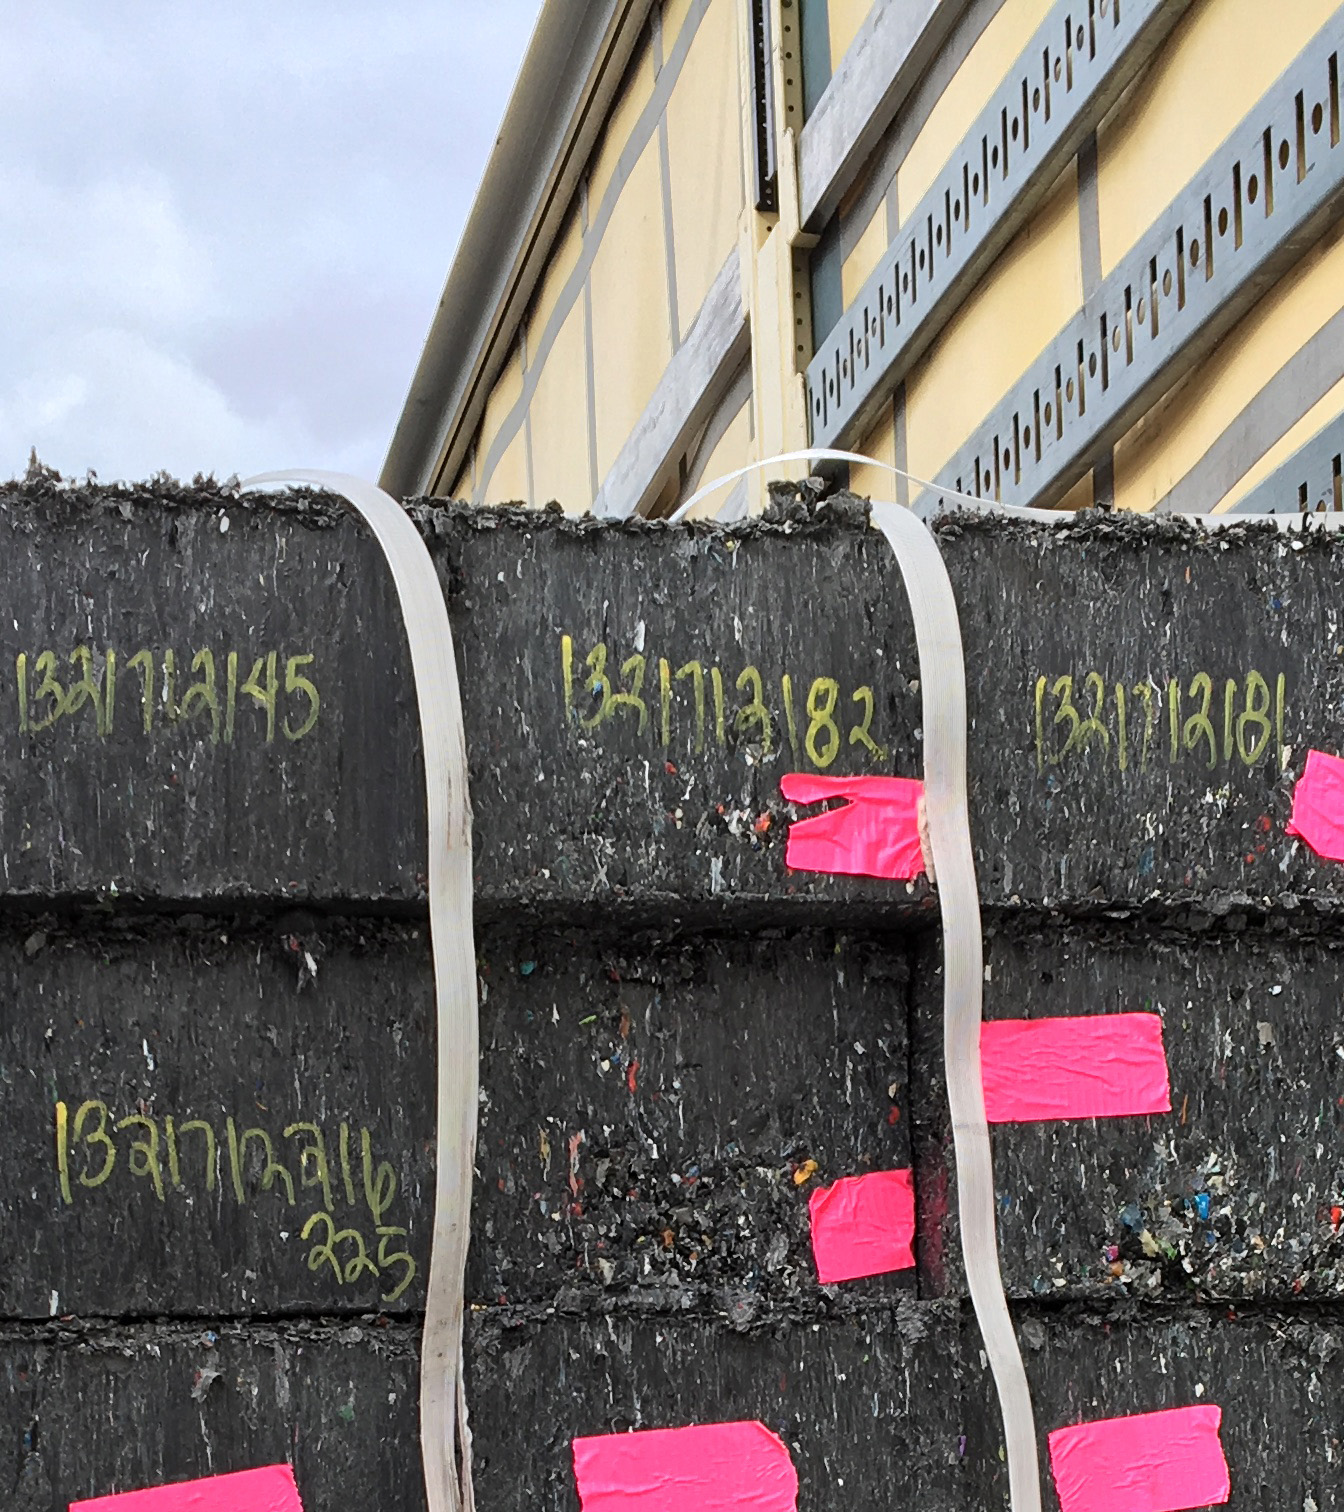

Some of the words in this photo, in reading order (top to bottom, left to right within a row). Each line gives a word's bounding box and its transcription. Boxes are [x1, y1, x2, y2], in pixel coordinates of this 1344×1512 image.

[17, 645, 320, 744] 1321712145
[561, 635, 888, 772] 1321712182
[1035, 670, 1286, 776] 1321712181
[56, 1100, 396, 1226] 1321712216
[300, 1211, 416, 1302] 225
